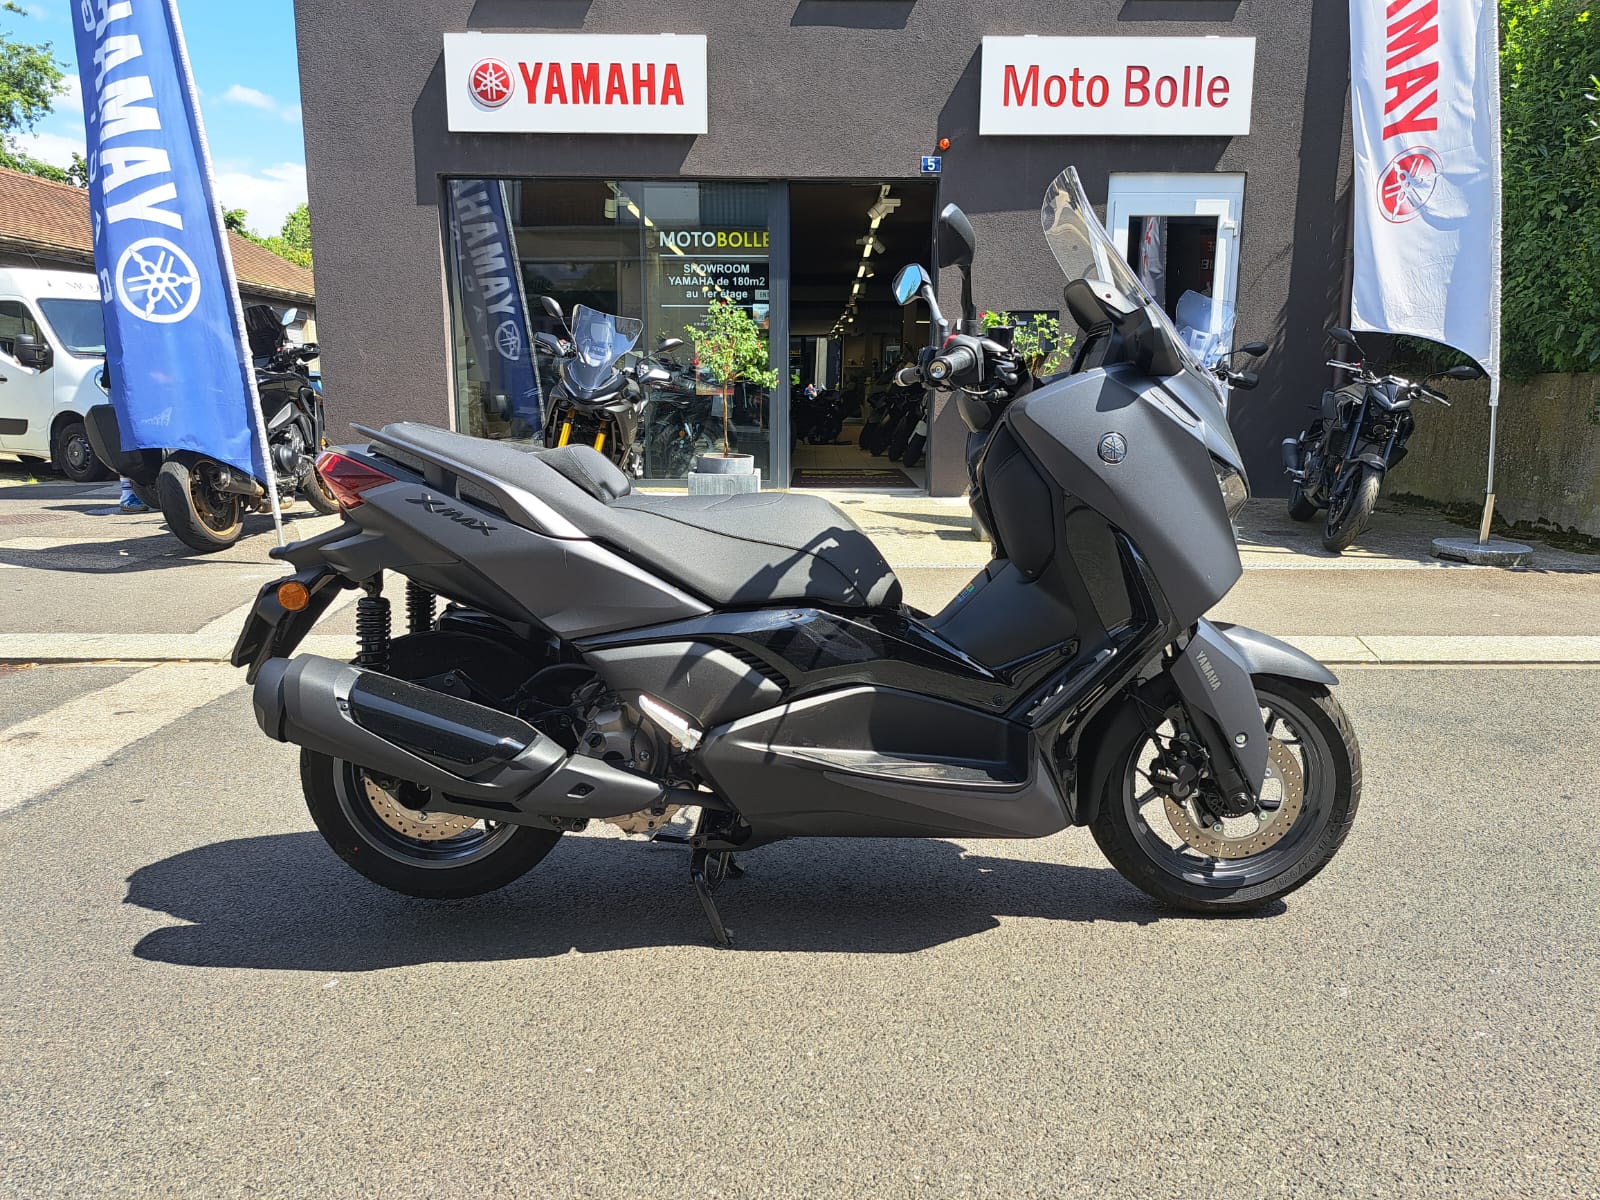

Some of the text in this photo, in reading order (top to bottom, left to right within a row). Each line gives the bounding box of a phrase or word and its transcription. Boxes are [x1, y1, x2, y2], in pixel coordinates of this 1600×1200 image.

[518, 62, 684, 106] YAMAHA
[1003, 65, 1230, 108] Moto Bolle
[927, 158, 936, 171] 5
[668, 276, 766, 286] YAMAHA de 180m2
[686, 290, 699, 298] au
[720, 288, 748, 300] étage
[404, 492, 499, 537] XMAX
[1195, 650, 1222, 691] YAMAHA
